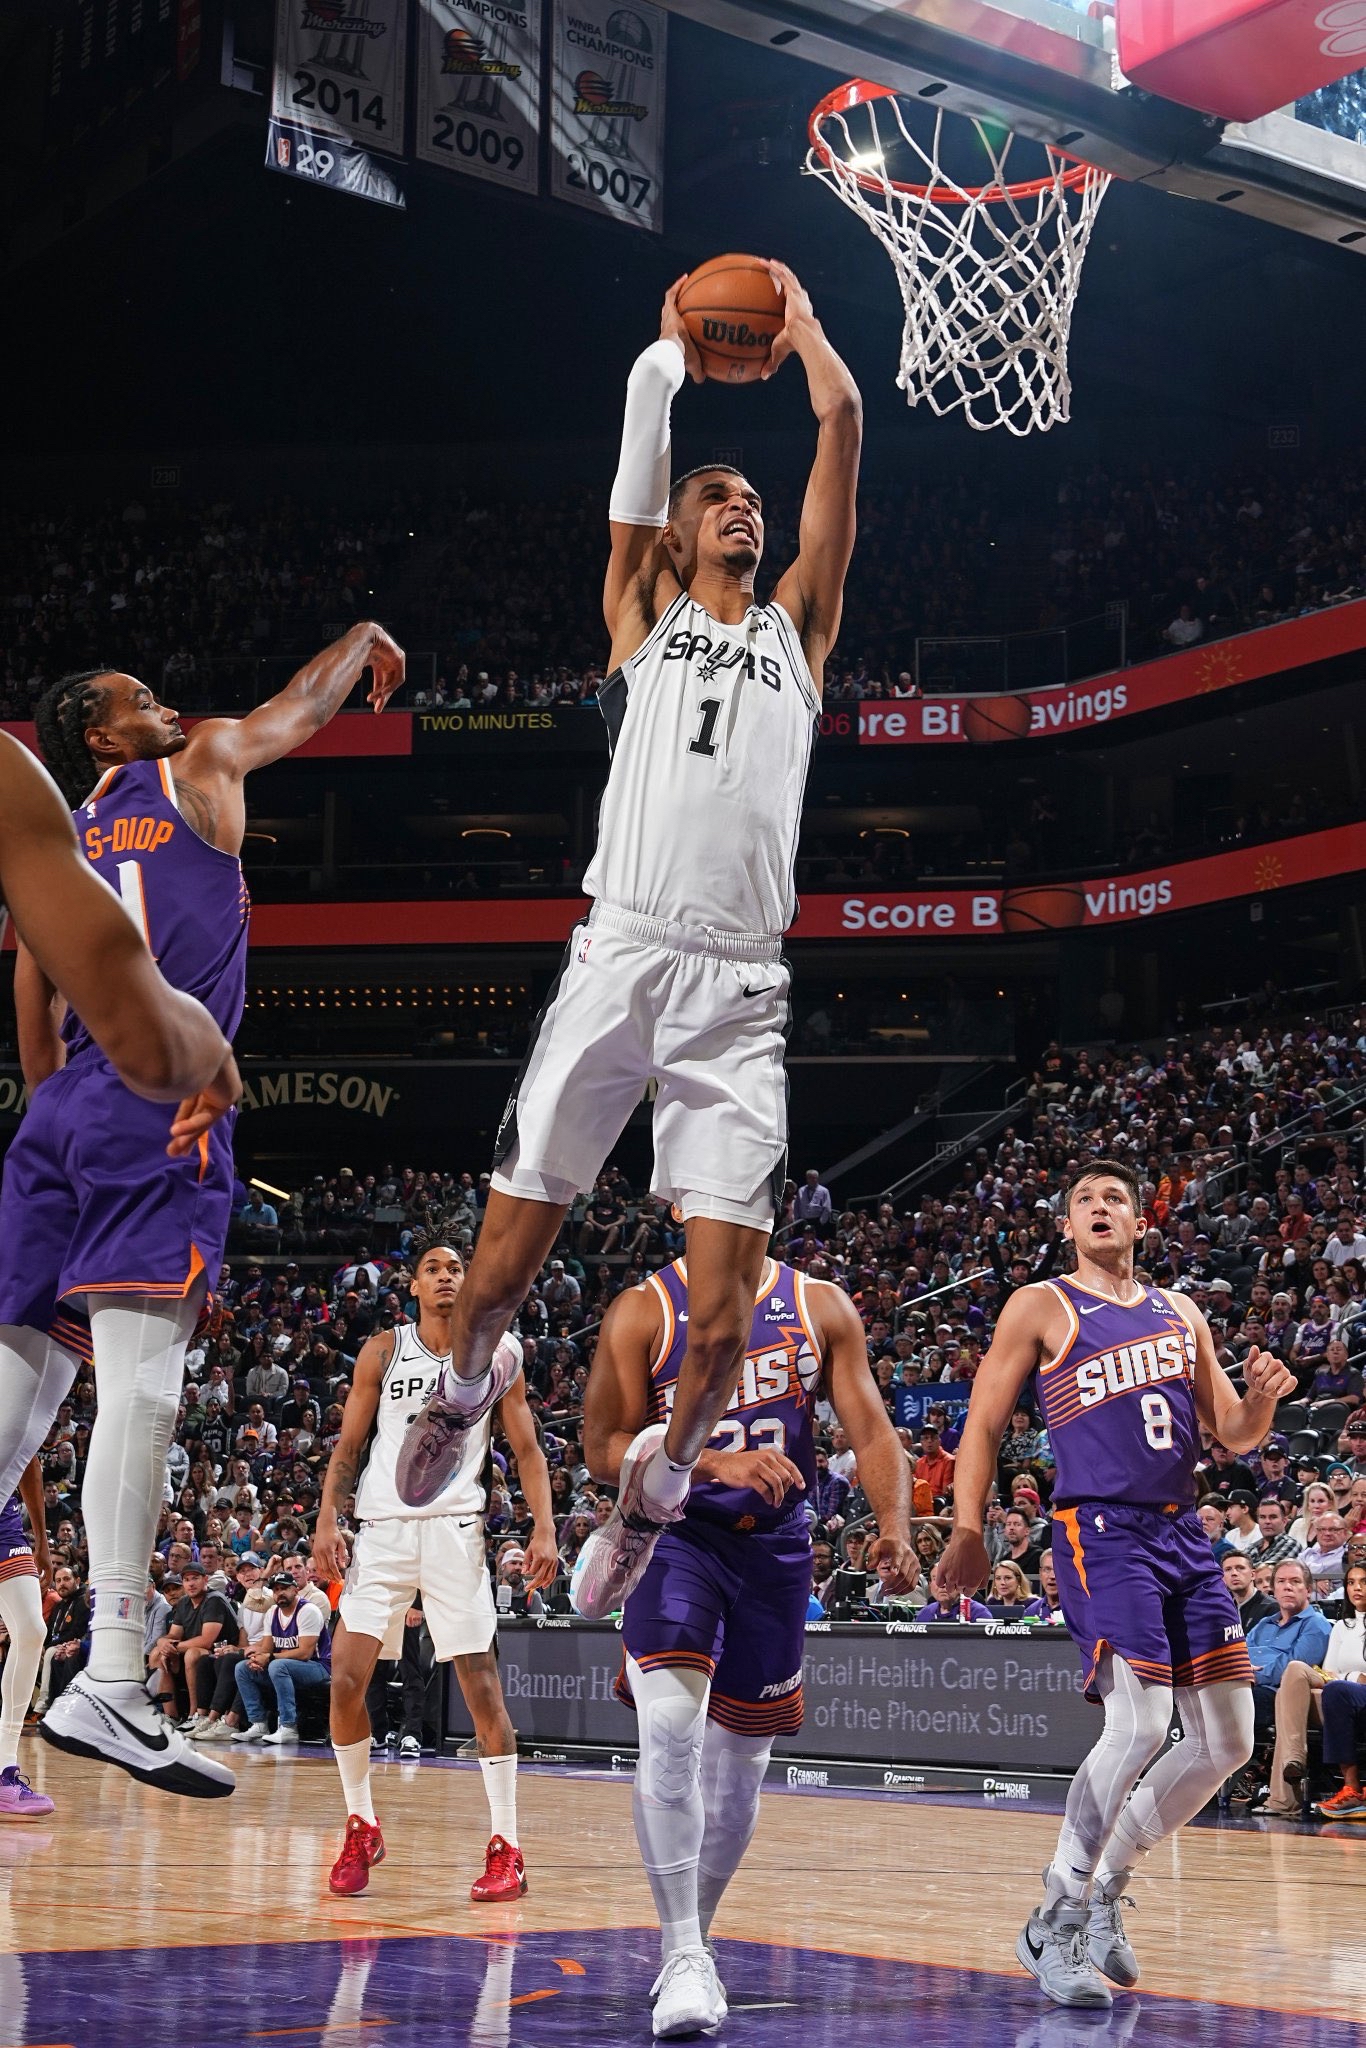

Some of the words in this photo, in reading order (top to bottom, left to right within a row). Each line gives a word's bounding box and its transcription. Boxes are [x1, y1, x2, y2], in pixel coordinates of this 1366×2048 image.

[567, 16, 602, 37] WNBA
[566, 29, 654, 70] CHAMPIONS
[292, 70, 386, 131] 2014
[432, 113, 524, 171] 2009
[295, 143, 335, 178] 29
[566, 153, 651, 209] 2007
[702, 317, 772, 347] Wilso
[748, 620, 774, 633] elf.
[663, 630, 782, 693] SPURS
[420, 715, 463, 731] TWO
[468, 713, 557, 730] MINUTES.
[922, 704, 960, 736] Bi
[1029, 684, 1127, 730] avings
[686, 696, 725, 760] 1
[85, 817, 175, 860] S-DIOP
[841, 899, 956, 930] Score
[971, 896, 998, 927] B
[1085, 879, 1172, 915] vings
[237, 1071, 395, 1118] AMESON
[764, 1312, 795, 1322] PayPal
[1140, 1393, 1173, 1450] 8
[804, 1623, 831, 1632] ANDUEL
[895, 1623, 928, 1633] FANDUEL
[996, 1625, 1032, 1635] FANDUEL
[505, 1664, 586, 1700] Banner
[802, 1654, 851, 1685] ficial
[858, 1655, 935, 1689] Health
[940, 1657, 998, 1691] Care
[814, 1698, 841, 1727] of
[843, 1699, 882, 1724] the
[888, 1700, 981, 1735] Phoenix
[987, 1703, 1049, 1738] Suns
